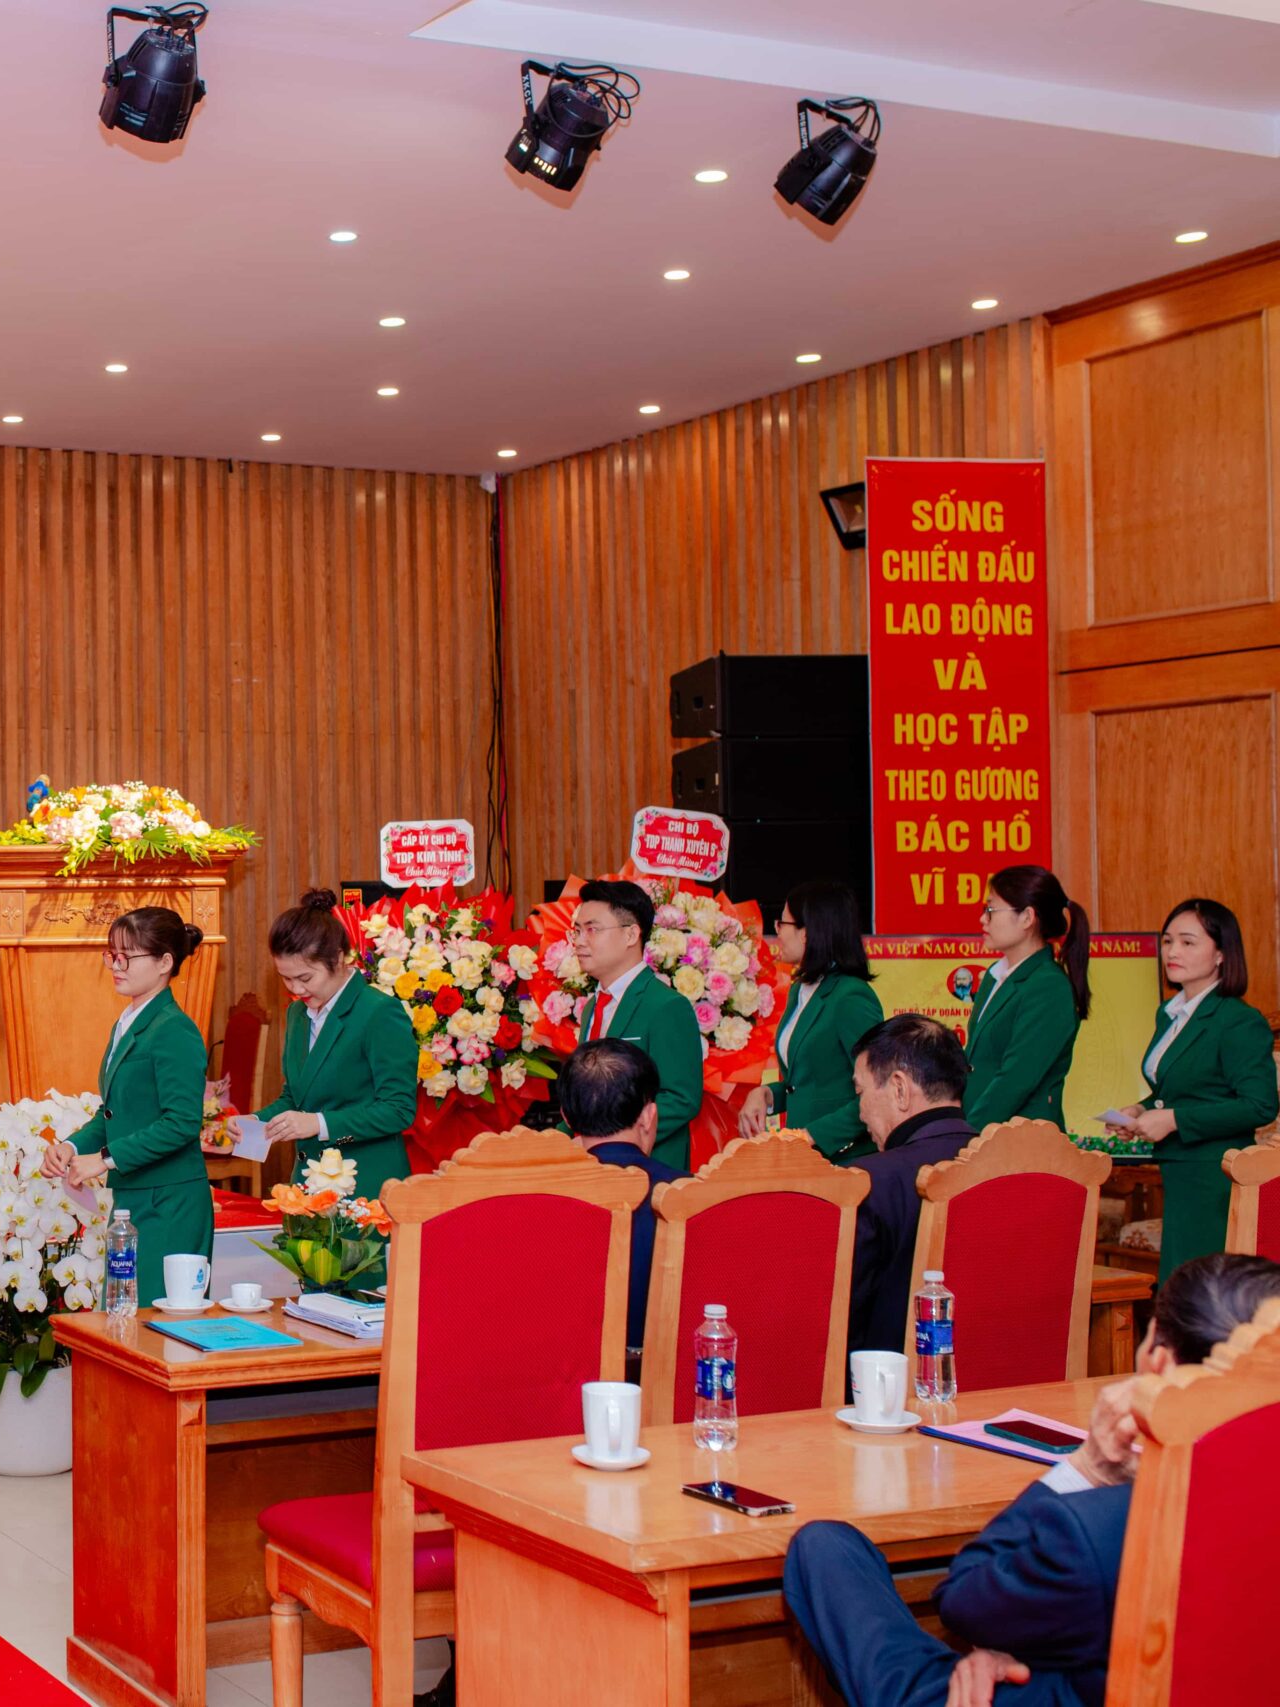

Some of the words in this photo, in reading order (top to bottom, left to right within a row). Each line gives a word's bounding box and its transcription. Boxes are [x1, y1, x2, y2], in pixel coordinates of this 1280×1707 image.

[911, 489, 1004, 533] SỐNG
[881, 539, 969, 582] CHIẾN
[977, 540, 1035, 583] ĐẤU
[885, 602, 941, 635] LAO
[950, 597, 1033, 643] ĐỘNG
[933, 652, 988, 690] VÀ
[894, 712, 958, 752] HỌC
[968, 707, 1029, 752] TẬP
[885, 769, 947, 801] THEO
[955, 766, 1039, 801] GƯƠNG
[402, 832, 418, 847] CẤP
[431, 834, 445, 846] CHI
[669, 820, 684, 833] CHI
[686, 822, 699, 838] BỘ
[895, 814, 970, 853] BÁC
[982, 810, 1032, 853] HỒ
[416, 850, 437, 863] KIM
[910, 866, 946, 905] VĨ
[886, 939, 920, 957] VIỆT
[922, 942, 956, 955] NAM
